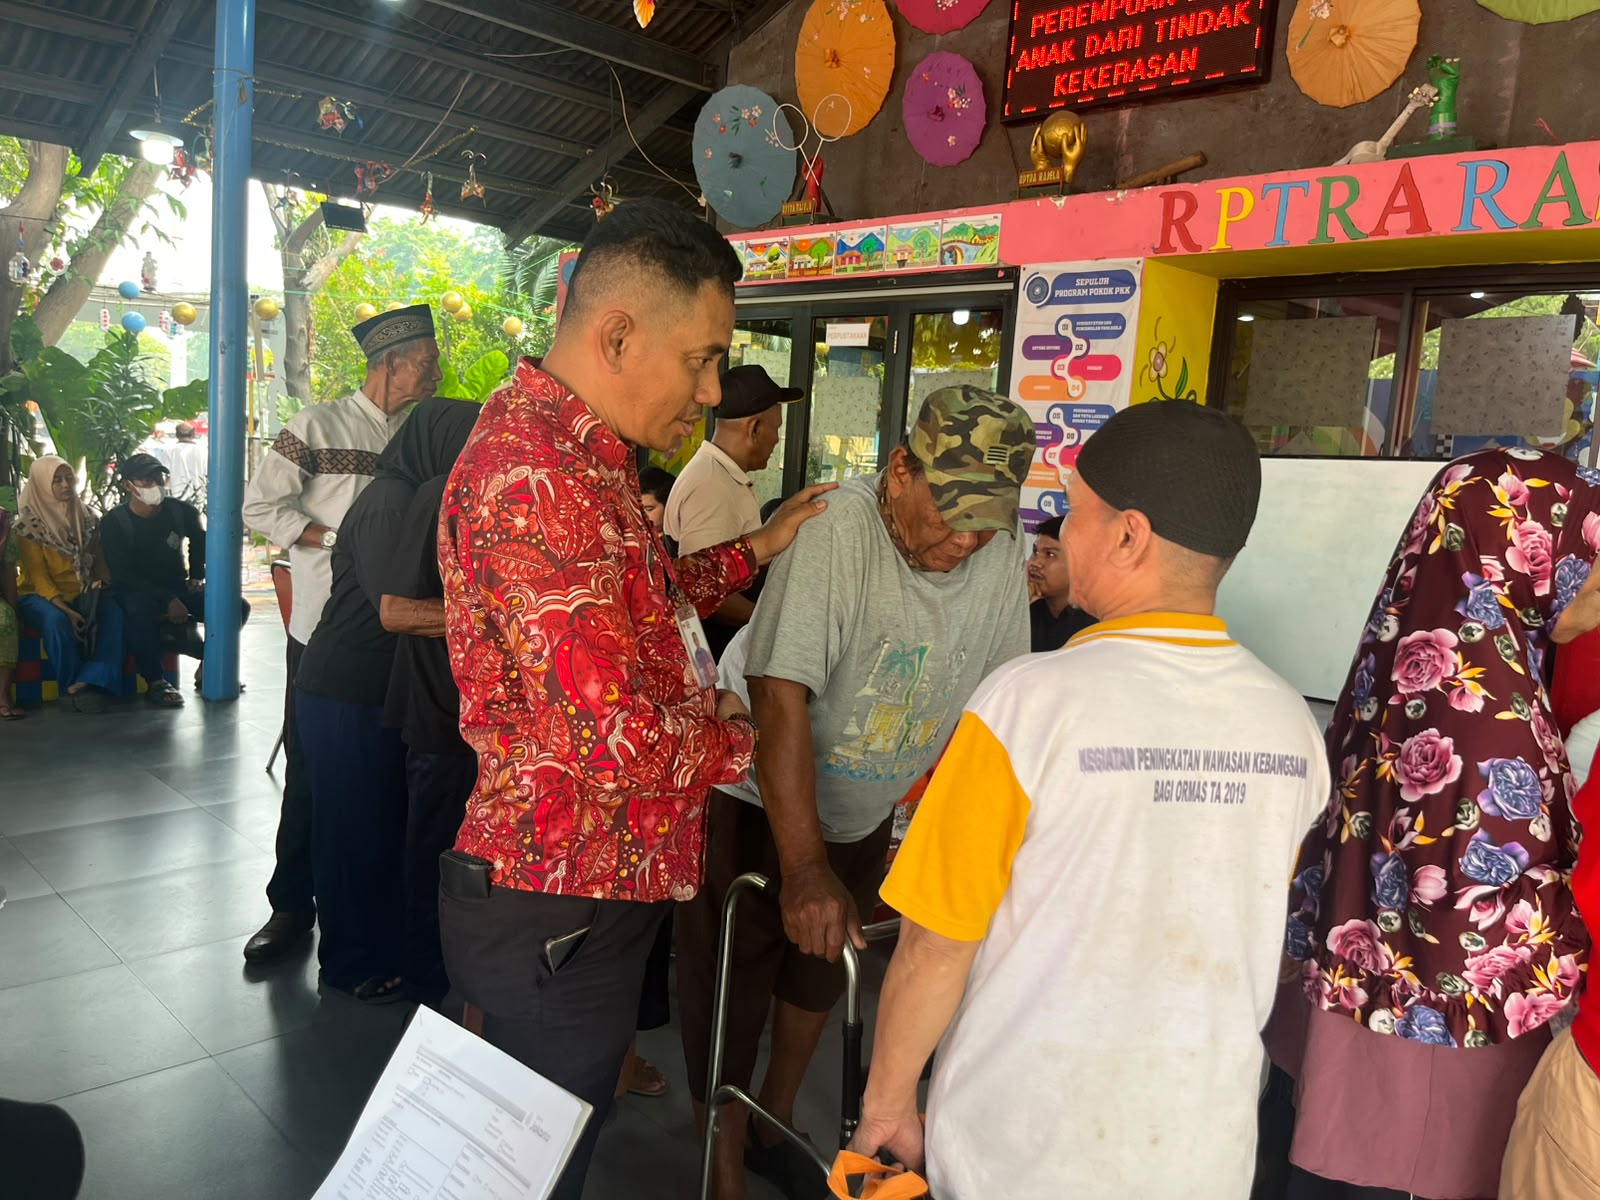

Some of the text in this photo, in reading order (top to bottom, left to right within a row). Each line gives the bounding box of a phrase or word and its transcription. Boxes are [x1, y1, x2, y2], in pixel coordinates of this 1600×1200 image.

[1030, 0, 1175, 38] PEREMPUA
[1015, 0, 1251, 73] ANAK DARI TINDAK
[1053, 46, 1199, 97] KEKERASAN
[1153, 151, 1600, 254] RPTRA RA
[1054, 286, 1131, 298] PROGRAM POKOK PKK
[1075, 277, 1109, 286] SEPULUH
[1137, 747, 1201, 772] PENINGKATAN
[1203, 749, 1251, 774] WAWASAN
[1153, 779, 1247, 804] BAGI ORMAS TA 2019
